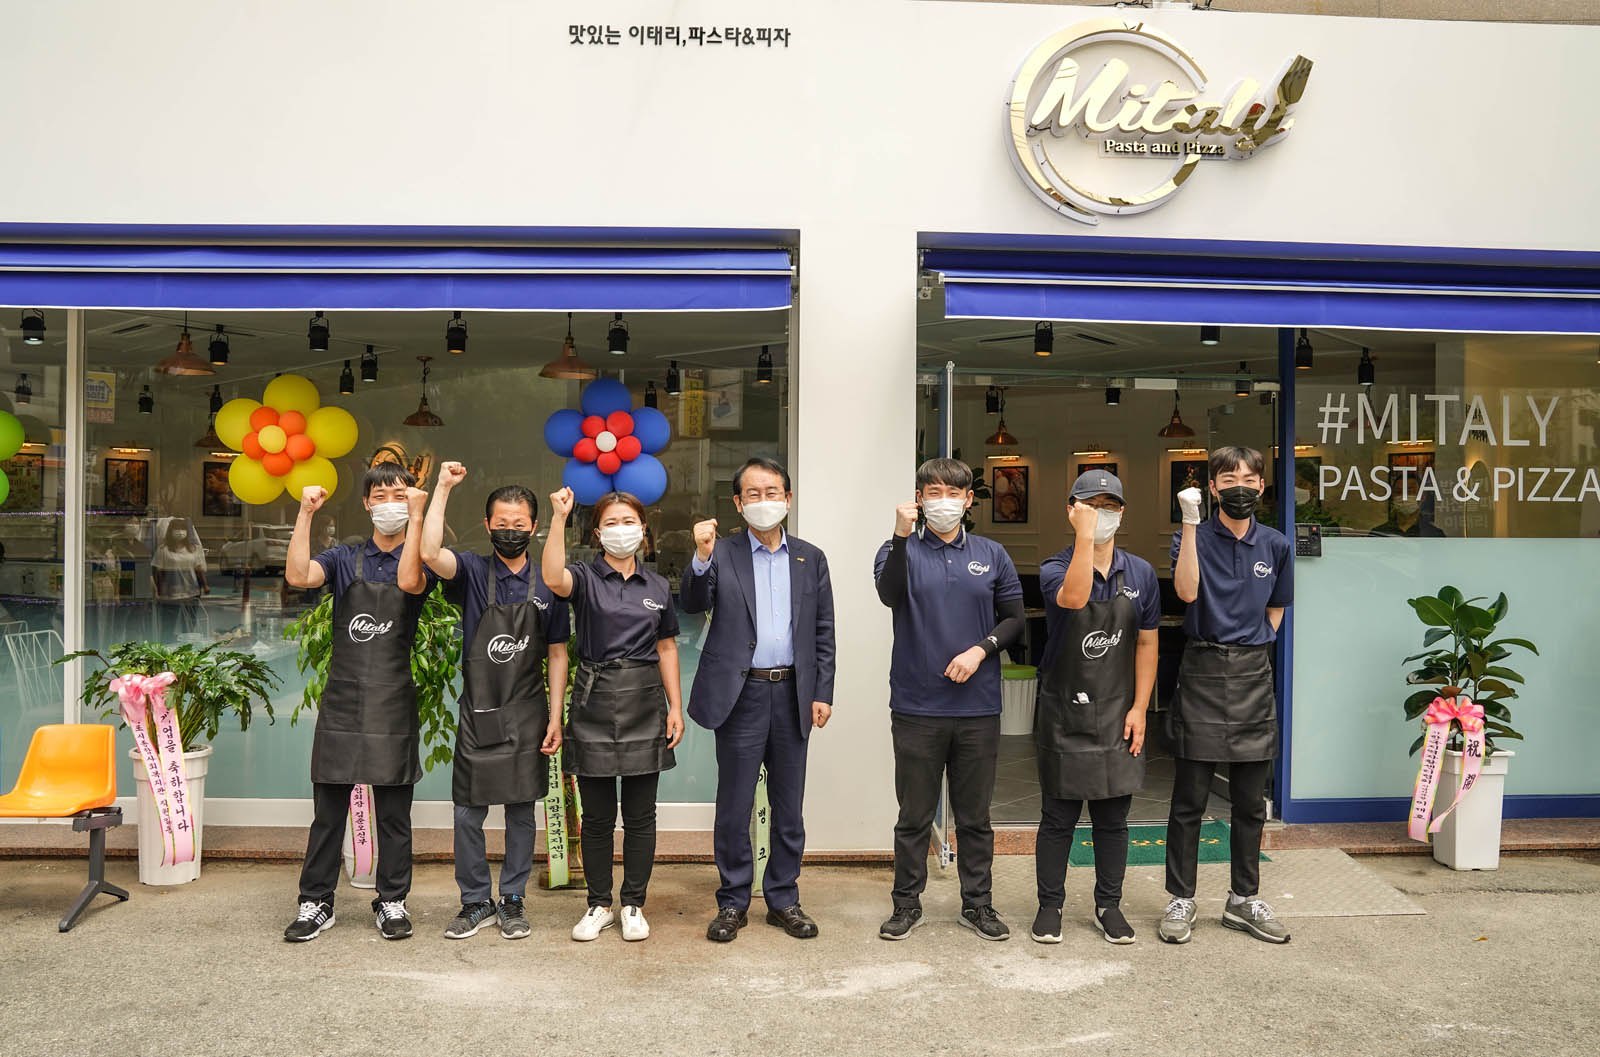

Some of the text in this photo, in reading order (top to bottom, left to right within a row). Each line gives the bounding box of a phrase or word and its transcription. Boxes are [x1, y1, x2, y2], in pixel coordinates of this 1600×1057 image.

[568, 24, 622, 46] 맛있는
[1030, 54, 1314, 150] Mitaly
[1104, 139, 1227, 155] Pasta and Pizza
[1317, 392, 1560, 447] #MITALY
[1319, 465, 1443, 502] PASTA
[1452, 466, 1480, 502] &
[1493, 467, 1600, 502] PIZZA
[351, 619, 394, 635] Mitaly
[491, 635, 530, 652] Mitaly
[1085, 629, 1123, 648] Mitaly
[168, 760, 190, 833] 축하합니다
